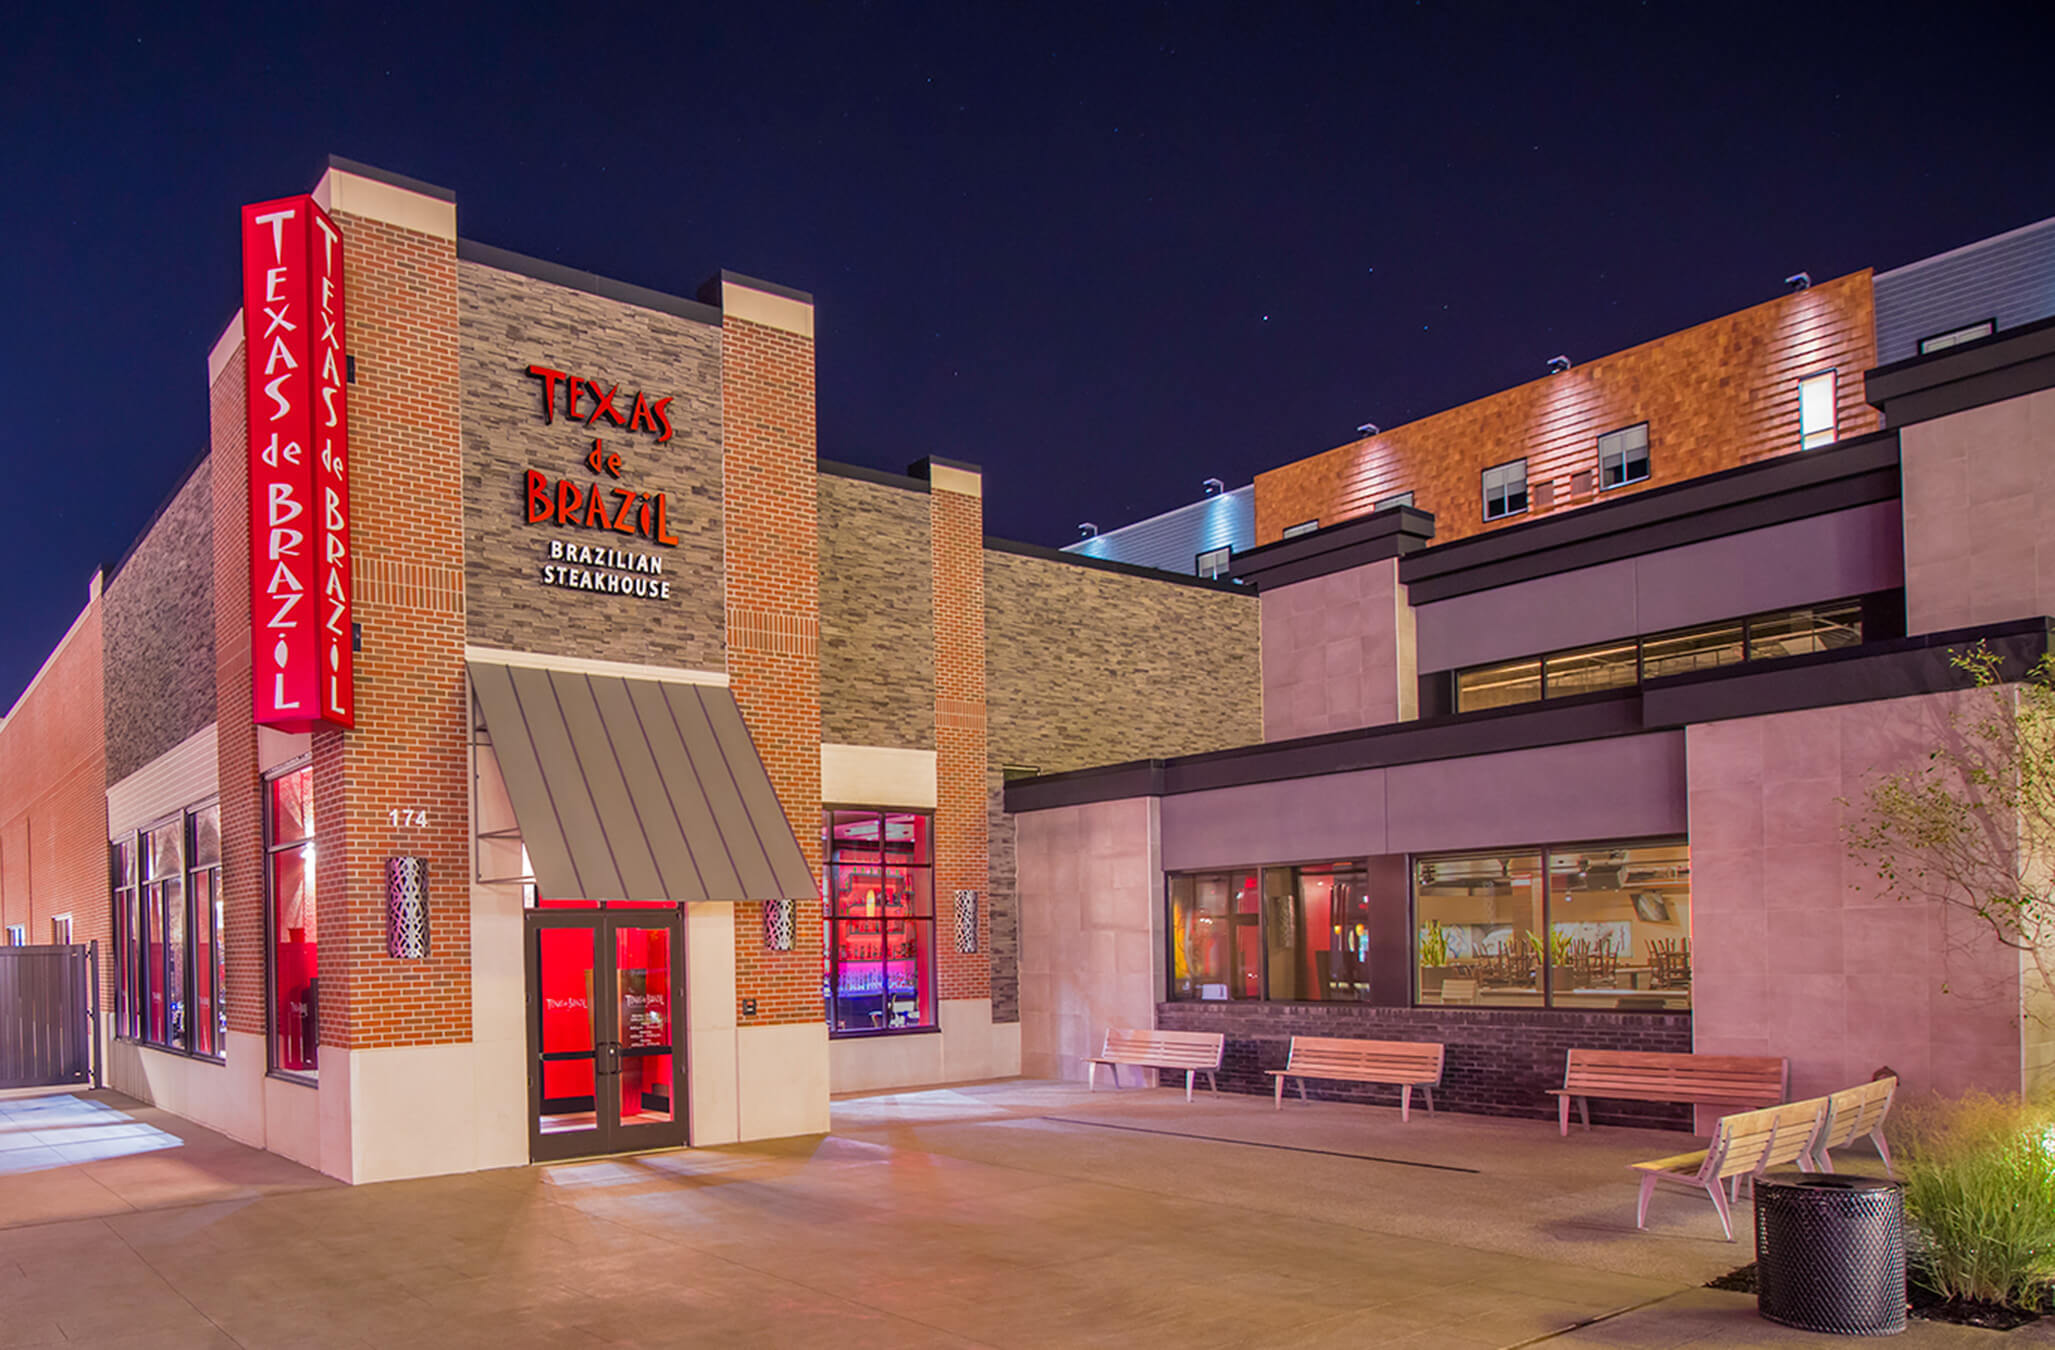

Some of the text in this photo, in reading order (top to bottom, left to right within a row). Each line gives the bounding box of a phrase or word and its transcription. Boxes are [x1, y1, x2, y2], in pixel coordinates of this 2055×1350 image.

[255, 209, 299, 421] TEXAS
[316, 215, 341, 428] TEXAS
[526, 364, 674, 443] TEXAS
[261, 433, 302, 468] de
[321, 438, 344, 481] de
[586, 438, 622, 478] de
[550, 540, 662, 575] BRAZILIAN
[543, 564, 671, 599] STEAKHOUSE
[388, 808, 428, 828] 174
